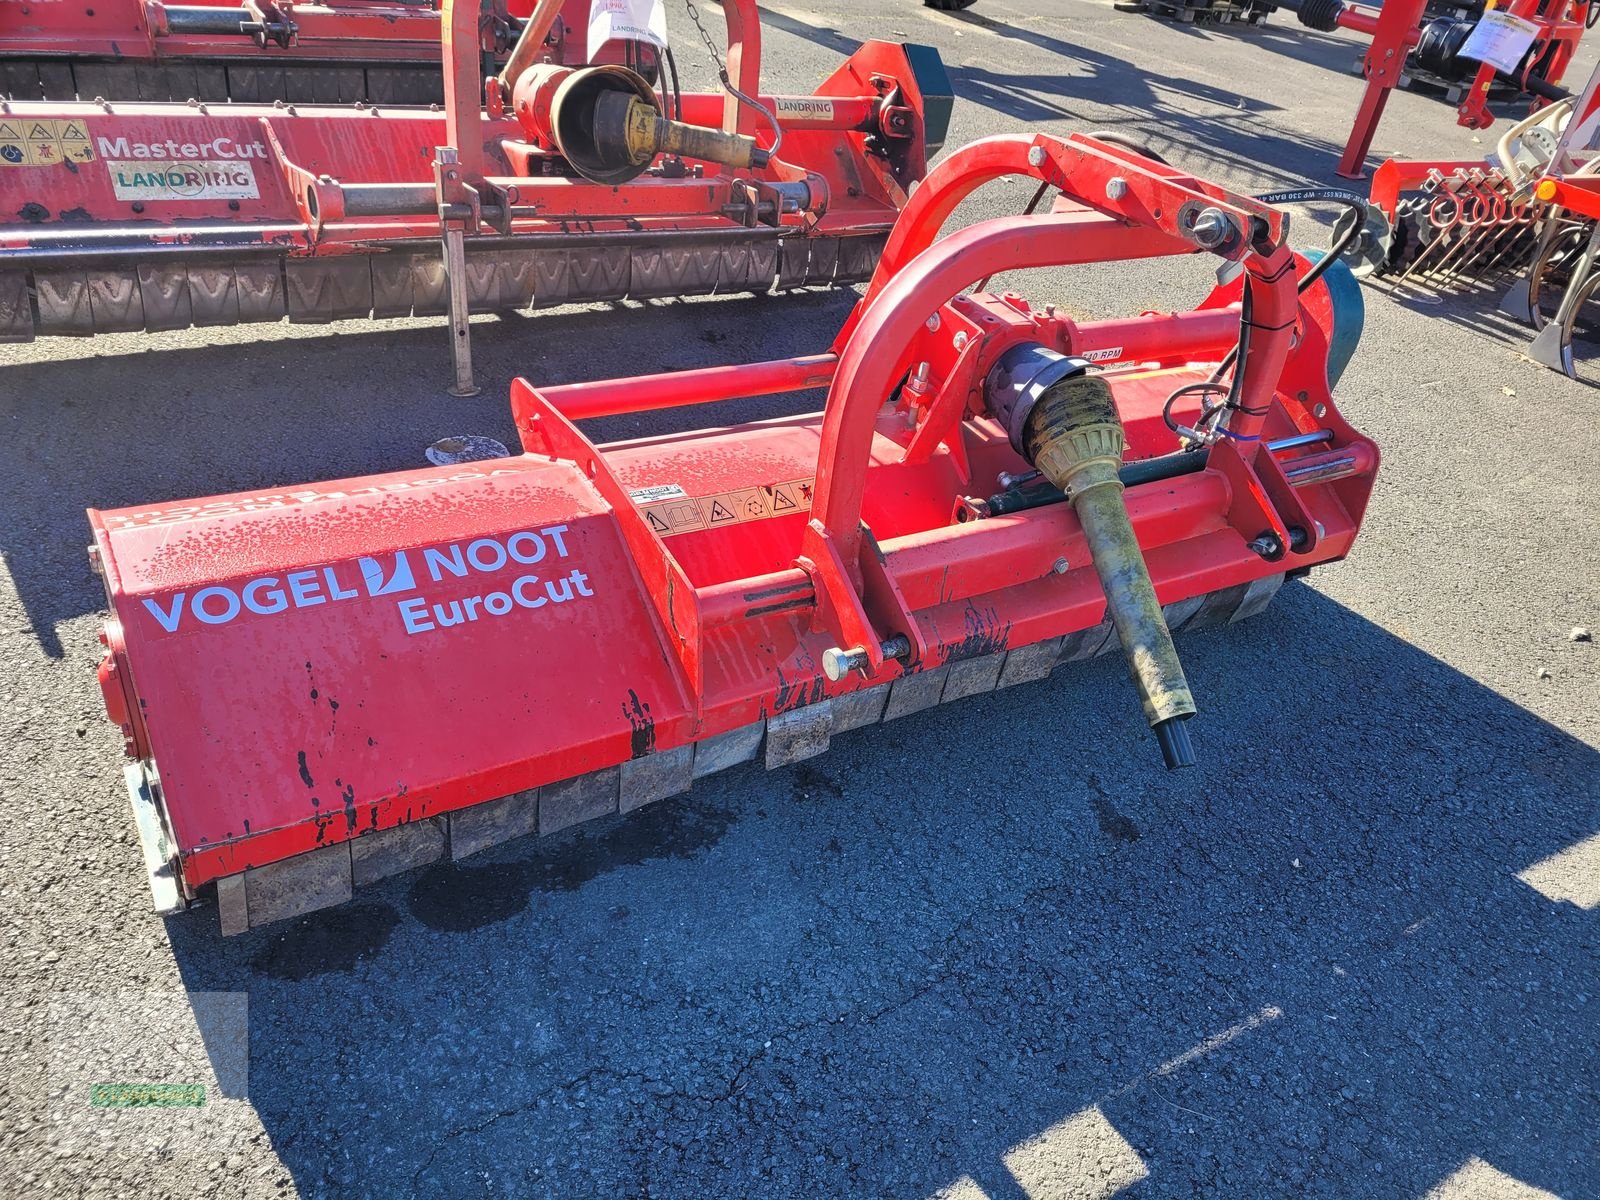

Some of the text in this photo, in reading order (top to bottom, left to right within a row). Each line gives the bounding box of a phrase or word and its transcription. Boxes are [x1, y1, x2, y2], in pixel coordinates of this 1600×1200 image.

[778, 102, 831, 113] LANDRING
[97, 136, 268, 159] MasterCut
[117, 171, 250, 187] LANDRING
[1269, 193, 1287, 202] BAR
[1100, 349, 1121, 359] RPM
[141, 525, 571, 633] VOGEL NOOT
[398, 569, 594, 634] EuroCut
